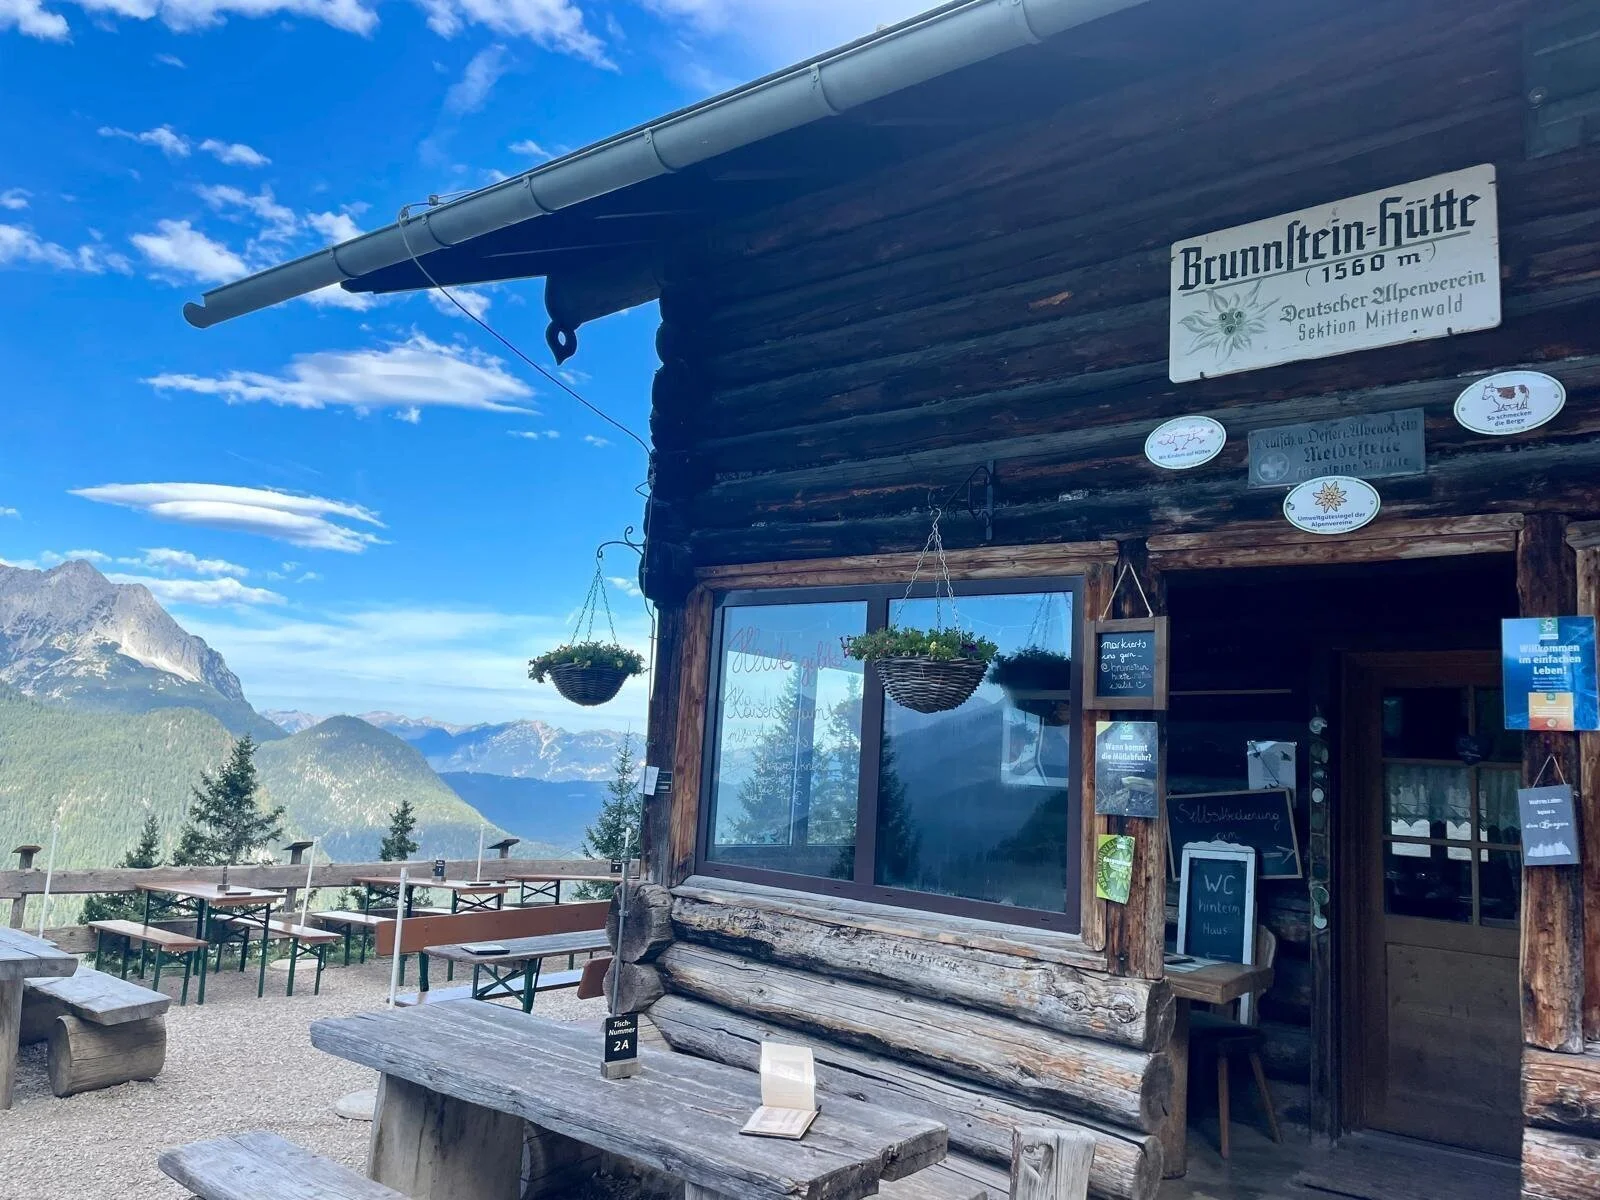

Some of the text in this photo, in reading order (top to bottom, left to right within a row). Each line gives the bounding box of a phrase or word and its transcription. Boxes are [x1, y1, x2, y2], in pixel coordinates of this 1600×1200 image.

[1280, 270, 1486, 326] Deutscher Alpenverein
[1299, 292, 1463, 341] Sektion Mittenwald
[1496, 410, 1532, 420] schmecken
[1506, 418, 1525, 426] Berge
[1321, 463, 1358, 476] alpine
[1297, 513, 1354, 522] Umweltgütesiegel
[1311, 519, 1353, 528] Alpenvereine
[1520, 643, 1580, 653] Willkommen
[1518, 654, 1582, 664] im einfachen
[1533, 665, 1567, 675] Leben!
[1105, 742, 1148, 752] Wann kommt
[1101, 752, 1152, 762] die Müllabfuhr?
[1204, 874, 1237, 895] WC
[1203, 922, 1229, 936] Haus
[613, 1019, 631, 1028] Tisch-
[608, 1027, 636, 1036] Nummer
